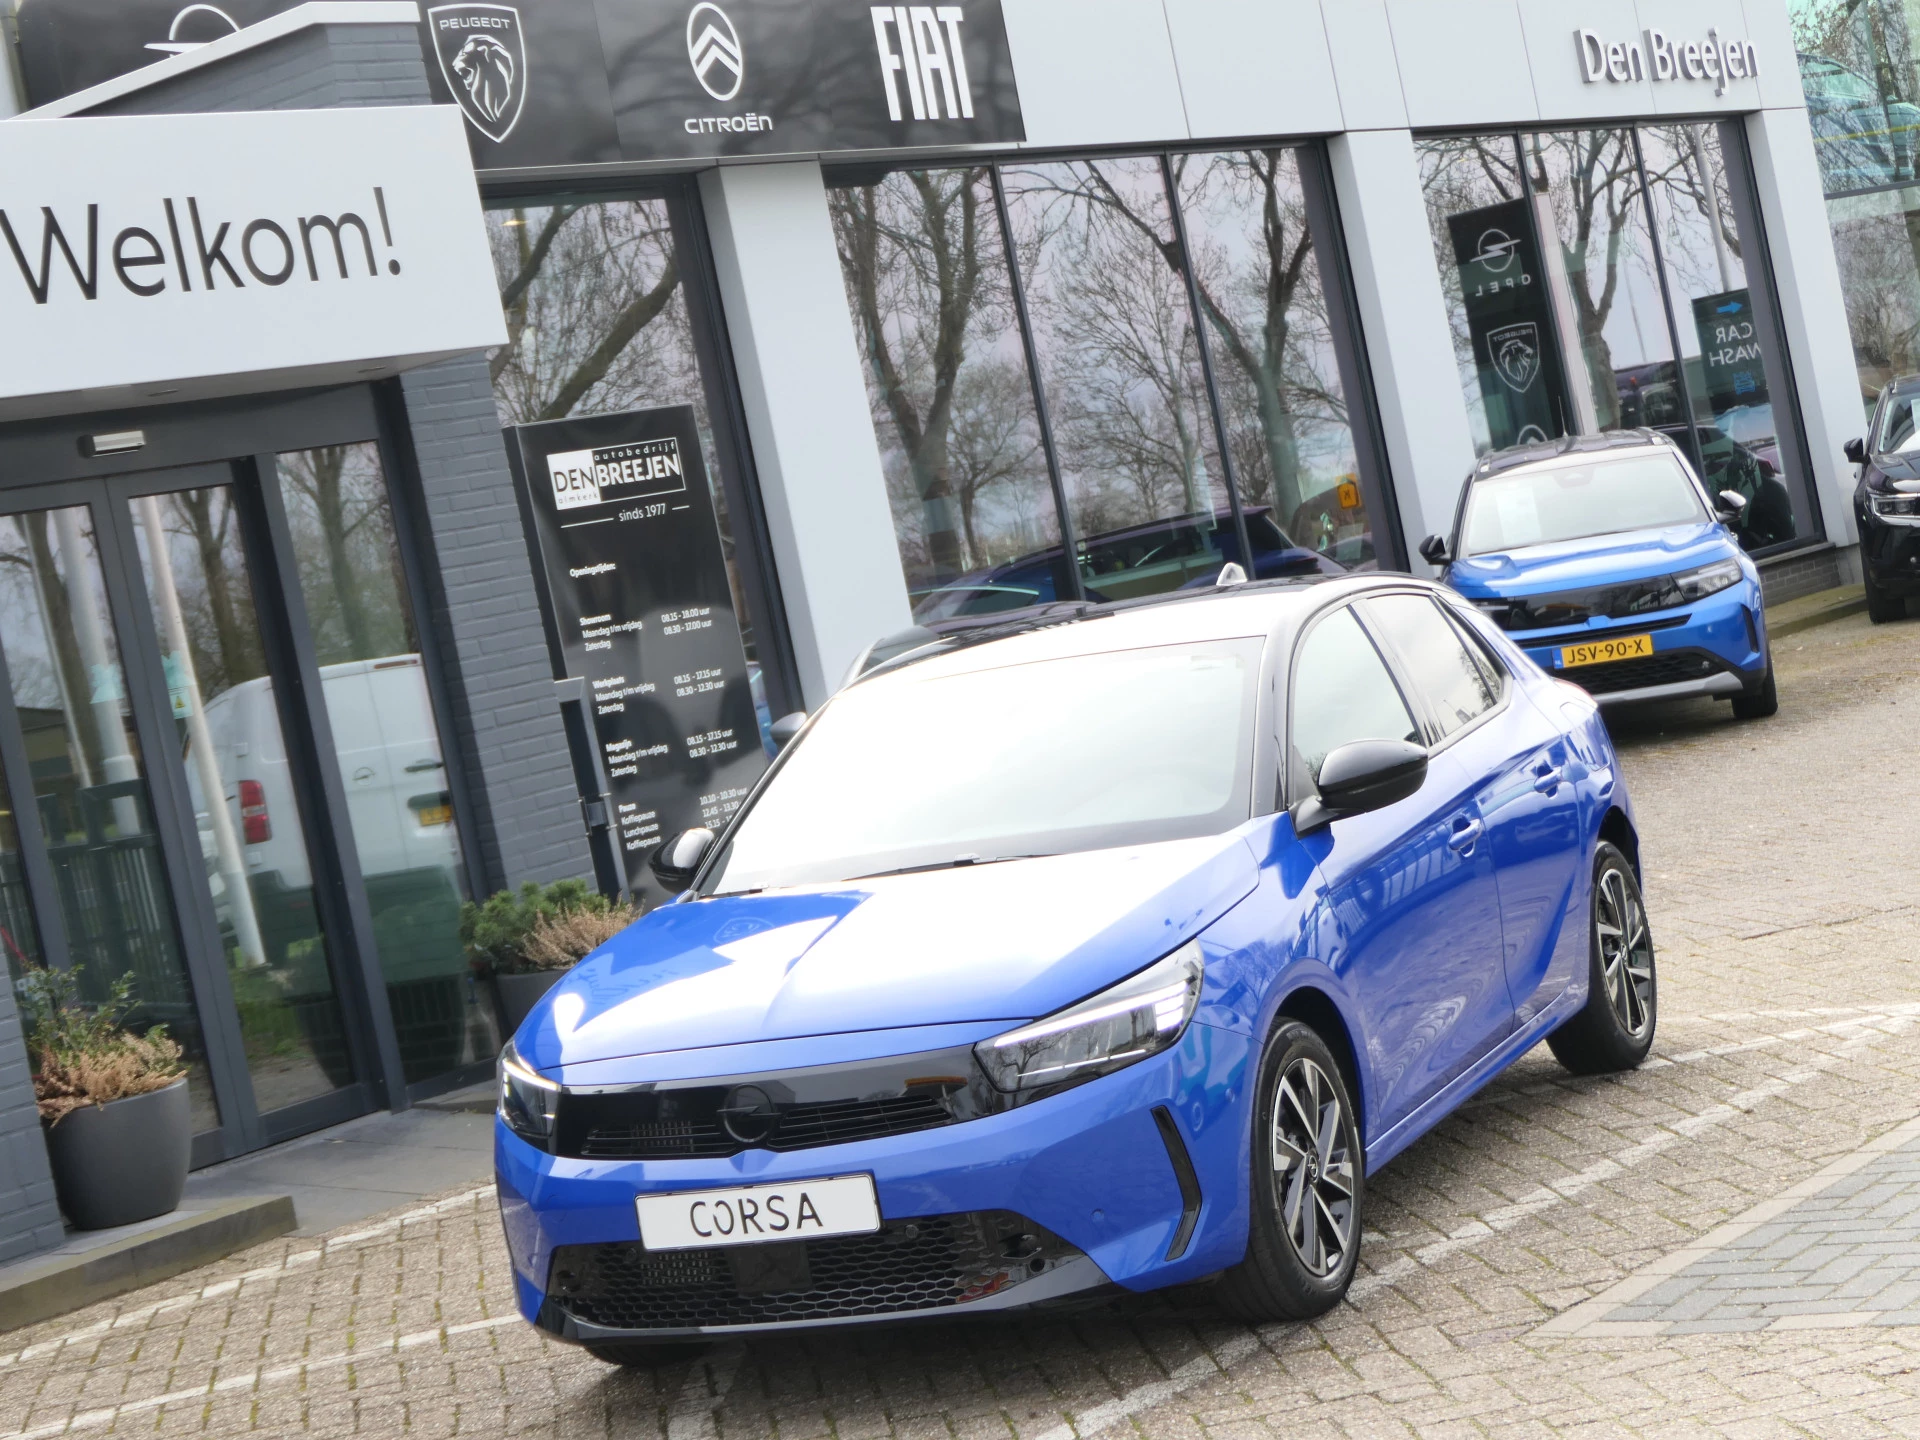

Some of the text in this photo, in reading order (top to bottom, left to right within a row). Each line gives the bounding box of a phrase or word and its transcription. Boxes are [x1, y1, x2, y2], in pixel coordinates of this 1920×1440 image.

[440, 16, 510, 30] PEUGEOT
[870, 6, 974, 121] FIAT
[1573, 26, 1761, 97] Den Breejen
[0, 186, 401, 304] Welkom!
[594, 441, 676, 461] autobedrijf
[553, 453, 681, 492] DEN BREEJEN
[558, 493, 599, 504] almkerk
[619, 502, 667, 522] sinds 1977
[579, 614, 612, 626] Showroom
[582, 627, 611, 639] Maandag
[1568, 638, 1645, 664] JSV-90-X
[690, 1192, 824, 1237] CORSA
